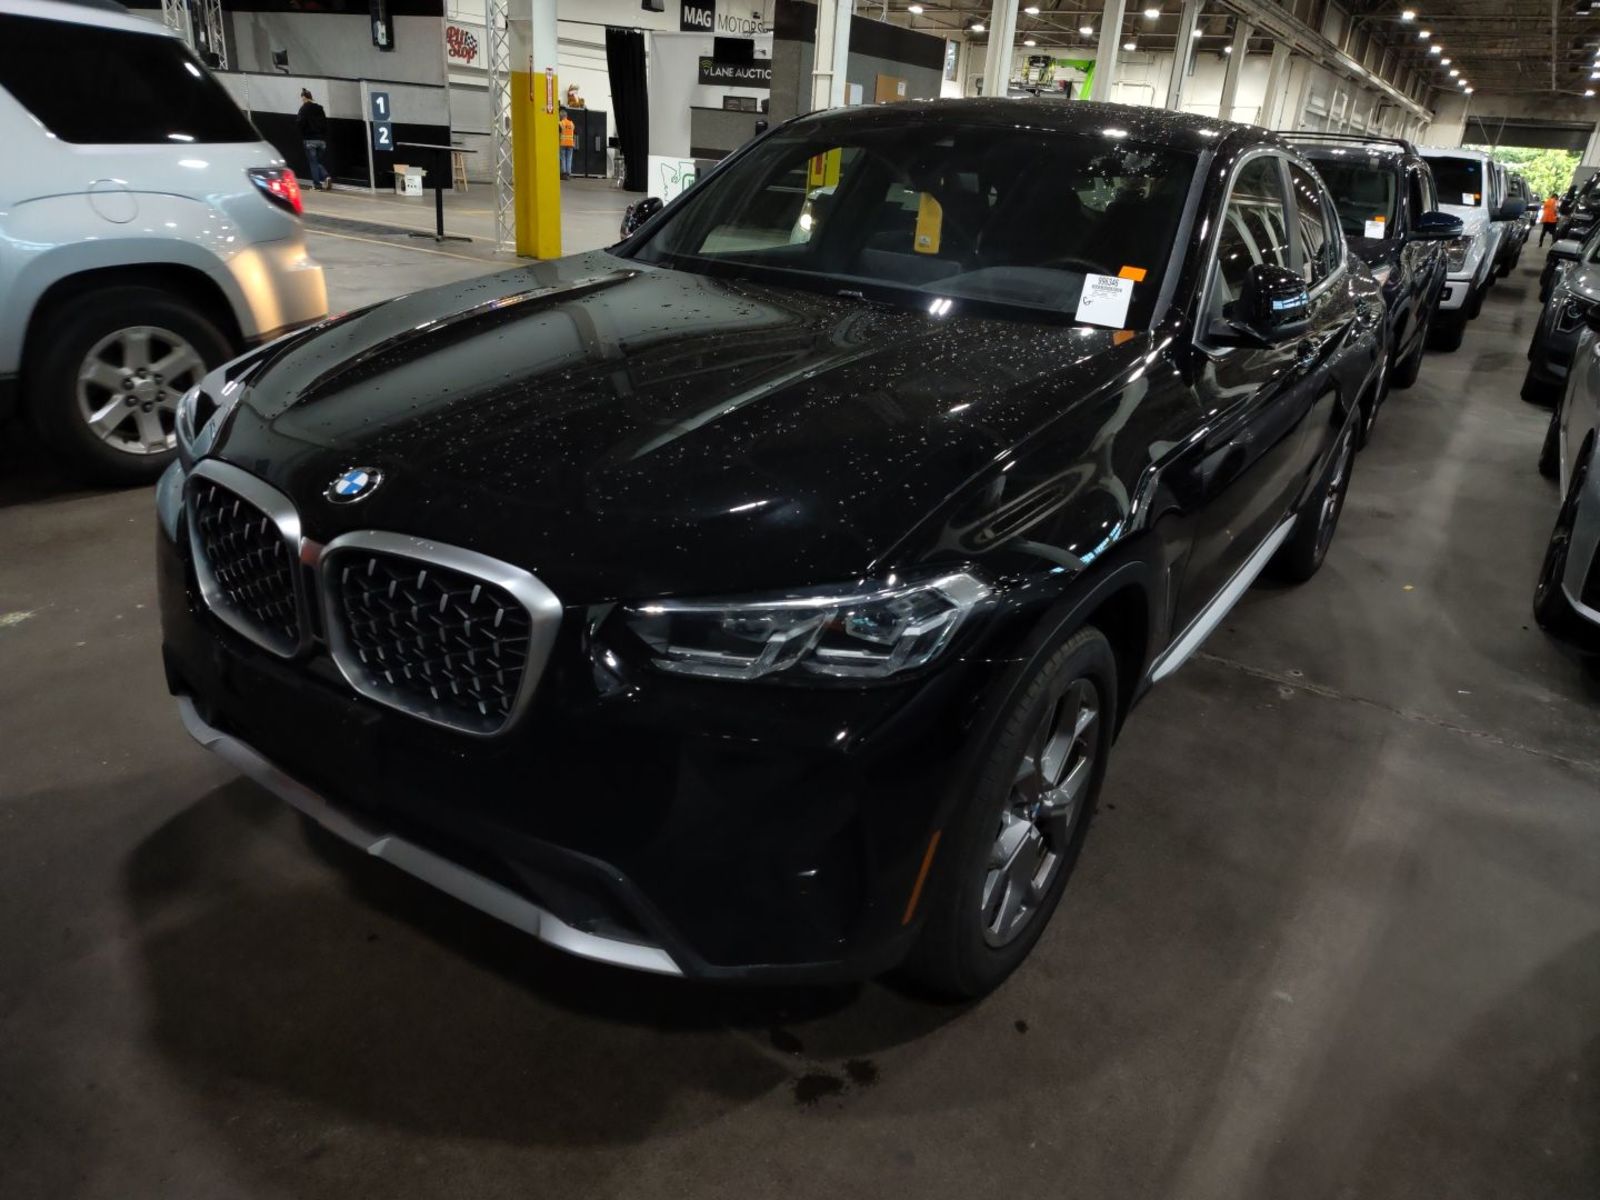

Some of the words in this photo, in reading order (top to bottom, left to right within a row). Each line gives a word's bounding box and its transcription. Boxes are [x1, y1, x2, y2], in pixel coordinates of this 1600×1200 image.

[684, 5, 712, 28] MAG
[718, 13, 763, 33] MOTORS
[448, 38, 477, 64] Stop
[376, 96, 385, 114] 1
[378, 126, 390, 144] 2
